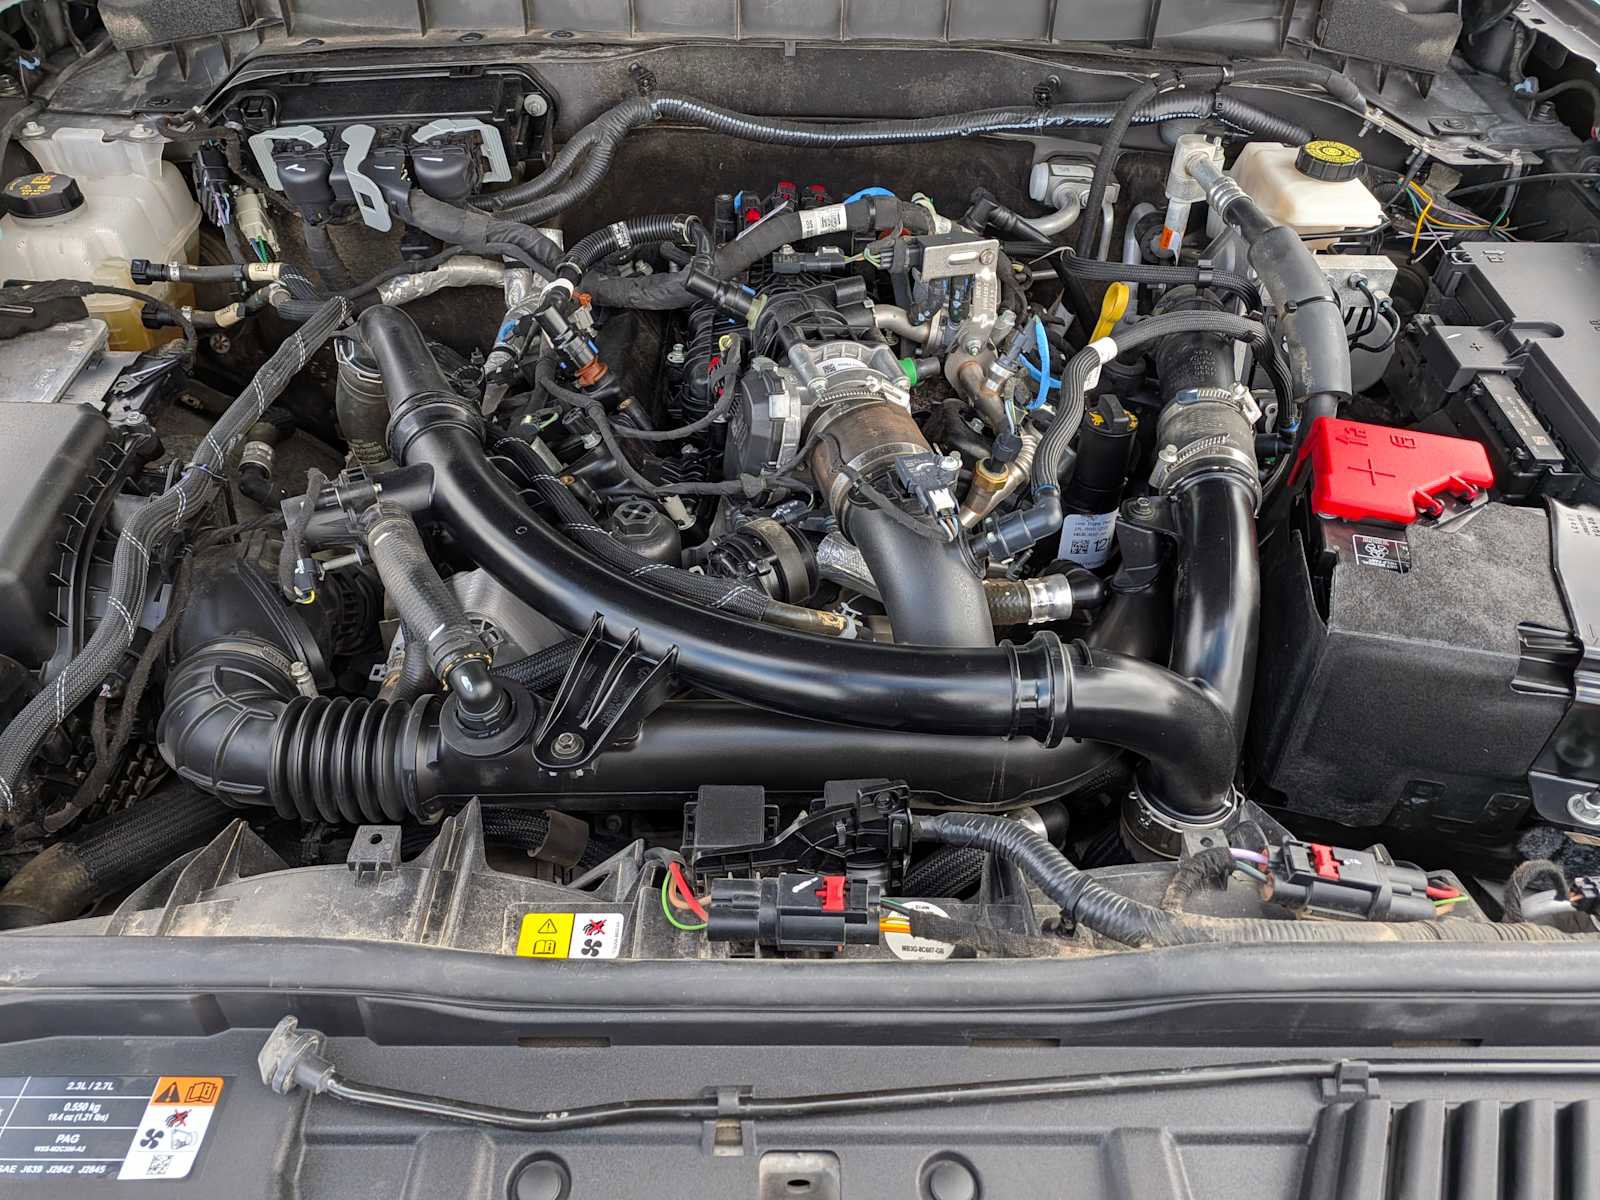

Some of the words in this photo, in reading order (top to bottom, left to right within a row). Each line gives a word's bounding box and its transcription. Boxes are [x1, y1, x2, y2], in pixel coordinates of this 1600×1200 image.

[88, 1102, 102, 1113] kg
[55, 1134, 80, 1144] PAG
[20, 1165, 44, 1174] J639
